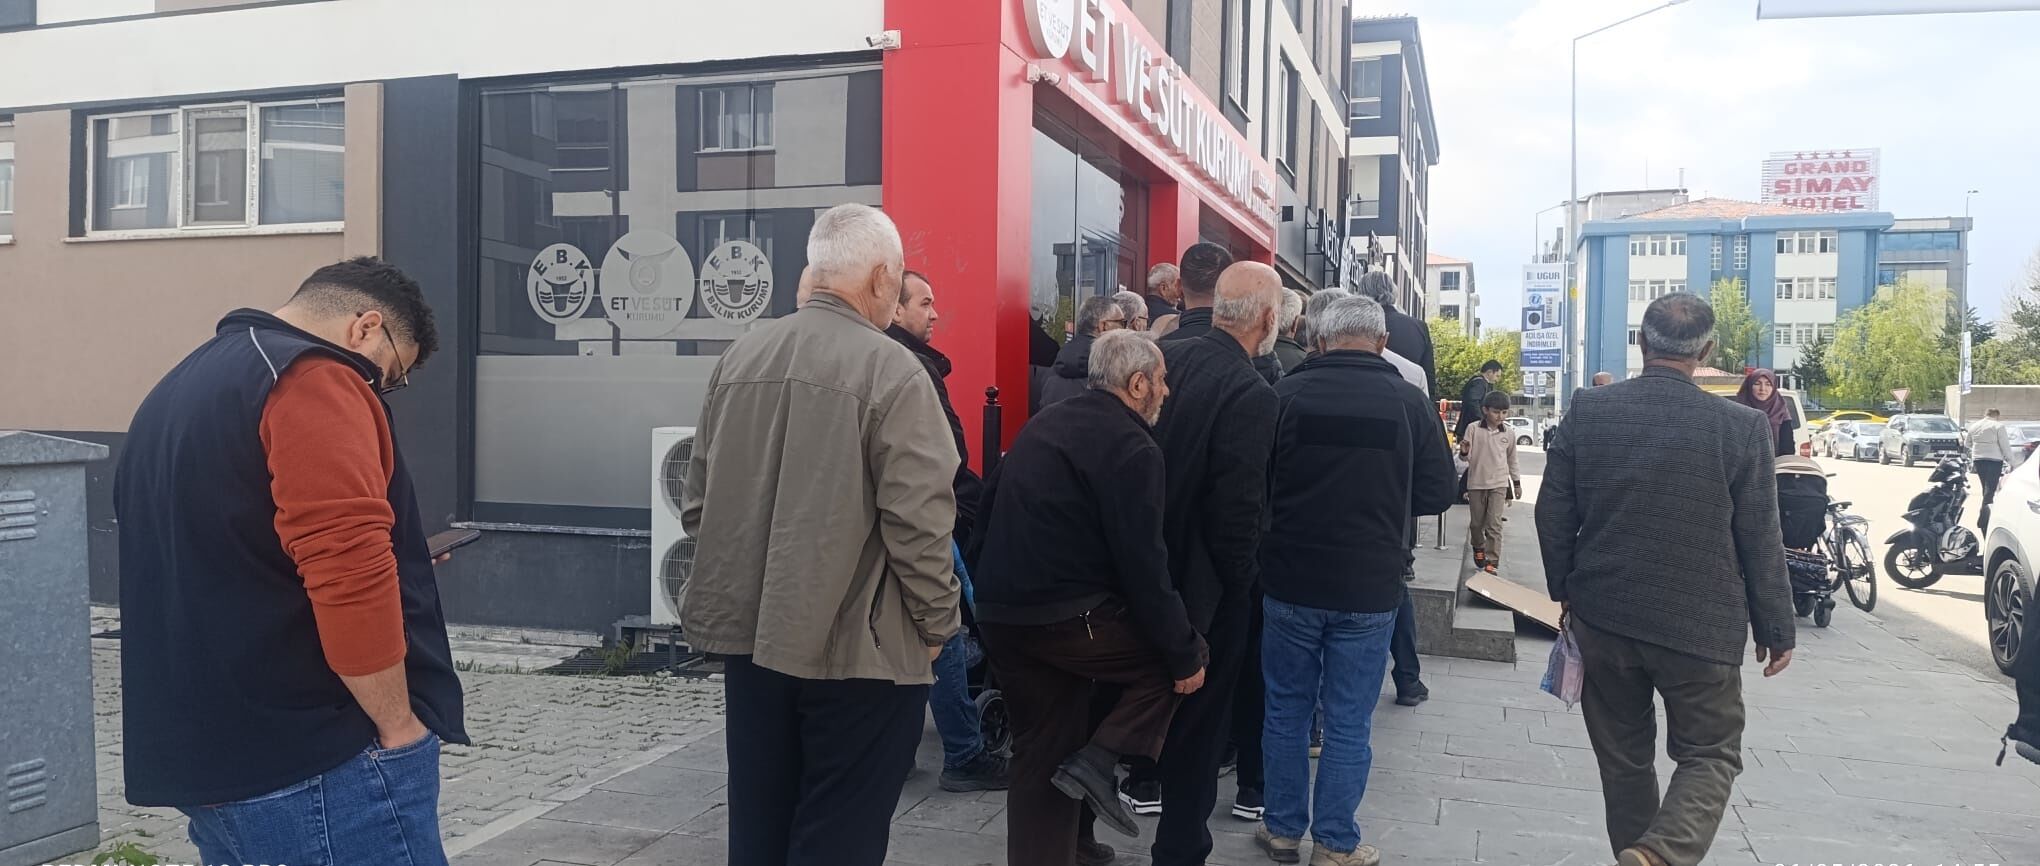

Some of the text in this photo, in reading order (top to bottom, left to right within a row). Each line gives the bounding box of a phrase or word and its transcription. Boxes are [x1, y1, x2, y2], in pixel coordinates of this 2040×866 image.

[1080, 0, 1253, 209] ET VE SÜT KURUMU
[1784, 160, 1867, 174] GRAND
[611, 296, 682, 312] ET VE SÜT
[703, 280, 769, 320] ET BALIK KURUMU
